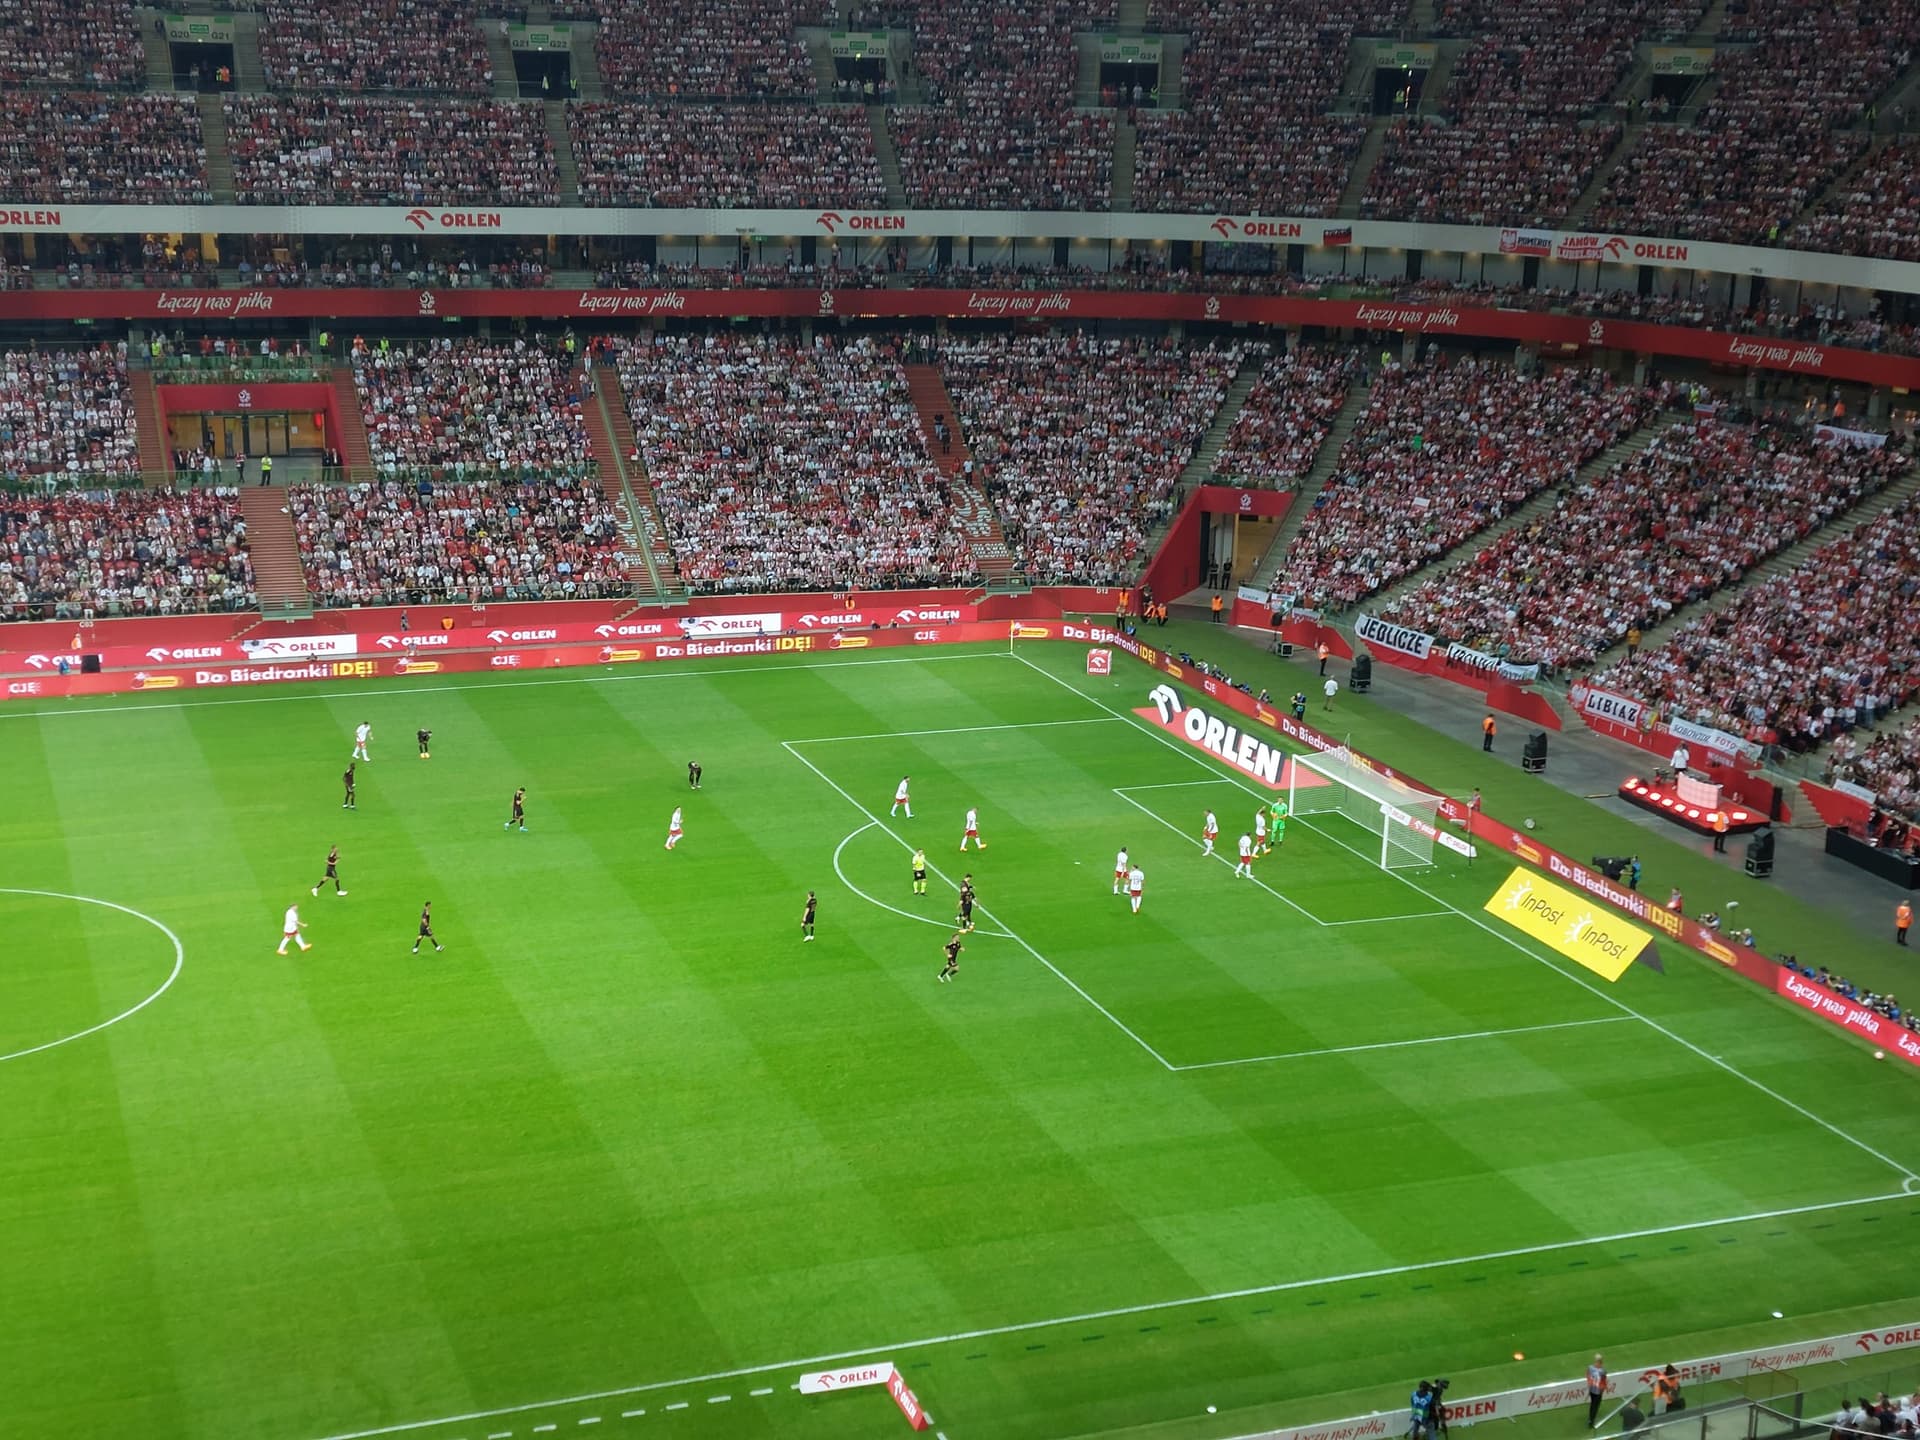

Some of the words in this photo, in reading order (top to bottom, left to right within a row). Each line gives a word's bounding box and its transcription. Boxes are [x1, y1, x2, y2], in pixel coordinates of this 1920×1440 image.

[0, 211, 61, 225] ORLEN
[440, 213, 501, 227] ORLEN
[849, 215, 905, 230] ORLEN
[1244, 222, 1301, 237] ORLEN
[1634, 243, 1688, 261] ORLEN
[157, 292, 202, 312] Łączy
[205, 296, 231, 309] nas
[233, 292, 273, 313] piłka
[579, 291, 619, 311] Łączy
[623, 295, 647, 308] nas
[649, 291, 685, 311] piłka
[968, 293, 1007, 312] Łączy
[1010, 295, 1034, 308] nas
[1035, 293, 1071, 313] piłka
[1356, 304, 1399, 326] Łączy
[1399, 310, 1422, 323] nas
[1423, 308, 1459, 328] piłka
[1729, 337, 1766, 361] Łączy
[1767, 347, 1789, 361] nas
[1789, 348, 1825, 367] piłka
[721, 619, 762, 629] ORLEN
[821, 614, 862, 625] ORLEN
[919, 610, 960, 620] ORLEN
[511, 630, 557, 640] ORLEN
[618, 625, 661, 635] ORLEN
[1360, 617, 1425, 655] JEDLICZE
[290, 641, 335, 652] ORLEN
[402, 635, 448, 646] ORLEN
[656, 645, 681, 657] Do
[687, 638, 772, 656] Biedronki
[776, 636, 811, 651] IDE!
[1063, 625, 1083, 639] Do
[1090, 628, 1139, 655] Biedronki
[1139, 647, 1156, 665] IDE!
[52, 654, 103, 666] ORL
[172, 647, 222, 659] ORLEN
[196, 671, 223, 684] Do
[230, 662, 328, 682] Biedronki
[332, 661, 374, 678] IDE!
[1283, 718, 1296, 735] Do
[1184, 708, 1283, 784] ORLEN
[1715, 736, 1737, 749] FOTO
[1521, 893, 1564, 925] InPost
[1582, 926, 1628, 960] InPost
[1785, 975, 1823, 1009] Łączy
[1823, 996, 1847, 1016] nas
[1845, 1010, 1880, 1035] piłka
[1785, 1350, 1806, 1363] nas
[1805, 1344, 1836, 1366] piłka
[840, 1370, 878, 1384] ORLEN
[900, 1391, 918, 1419] ORLEN
[1527, 1391, 1562, 1409] Łączy
[1353, 1419, 1386, 1440] piłka
